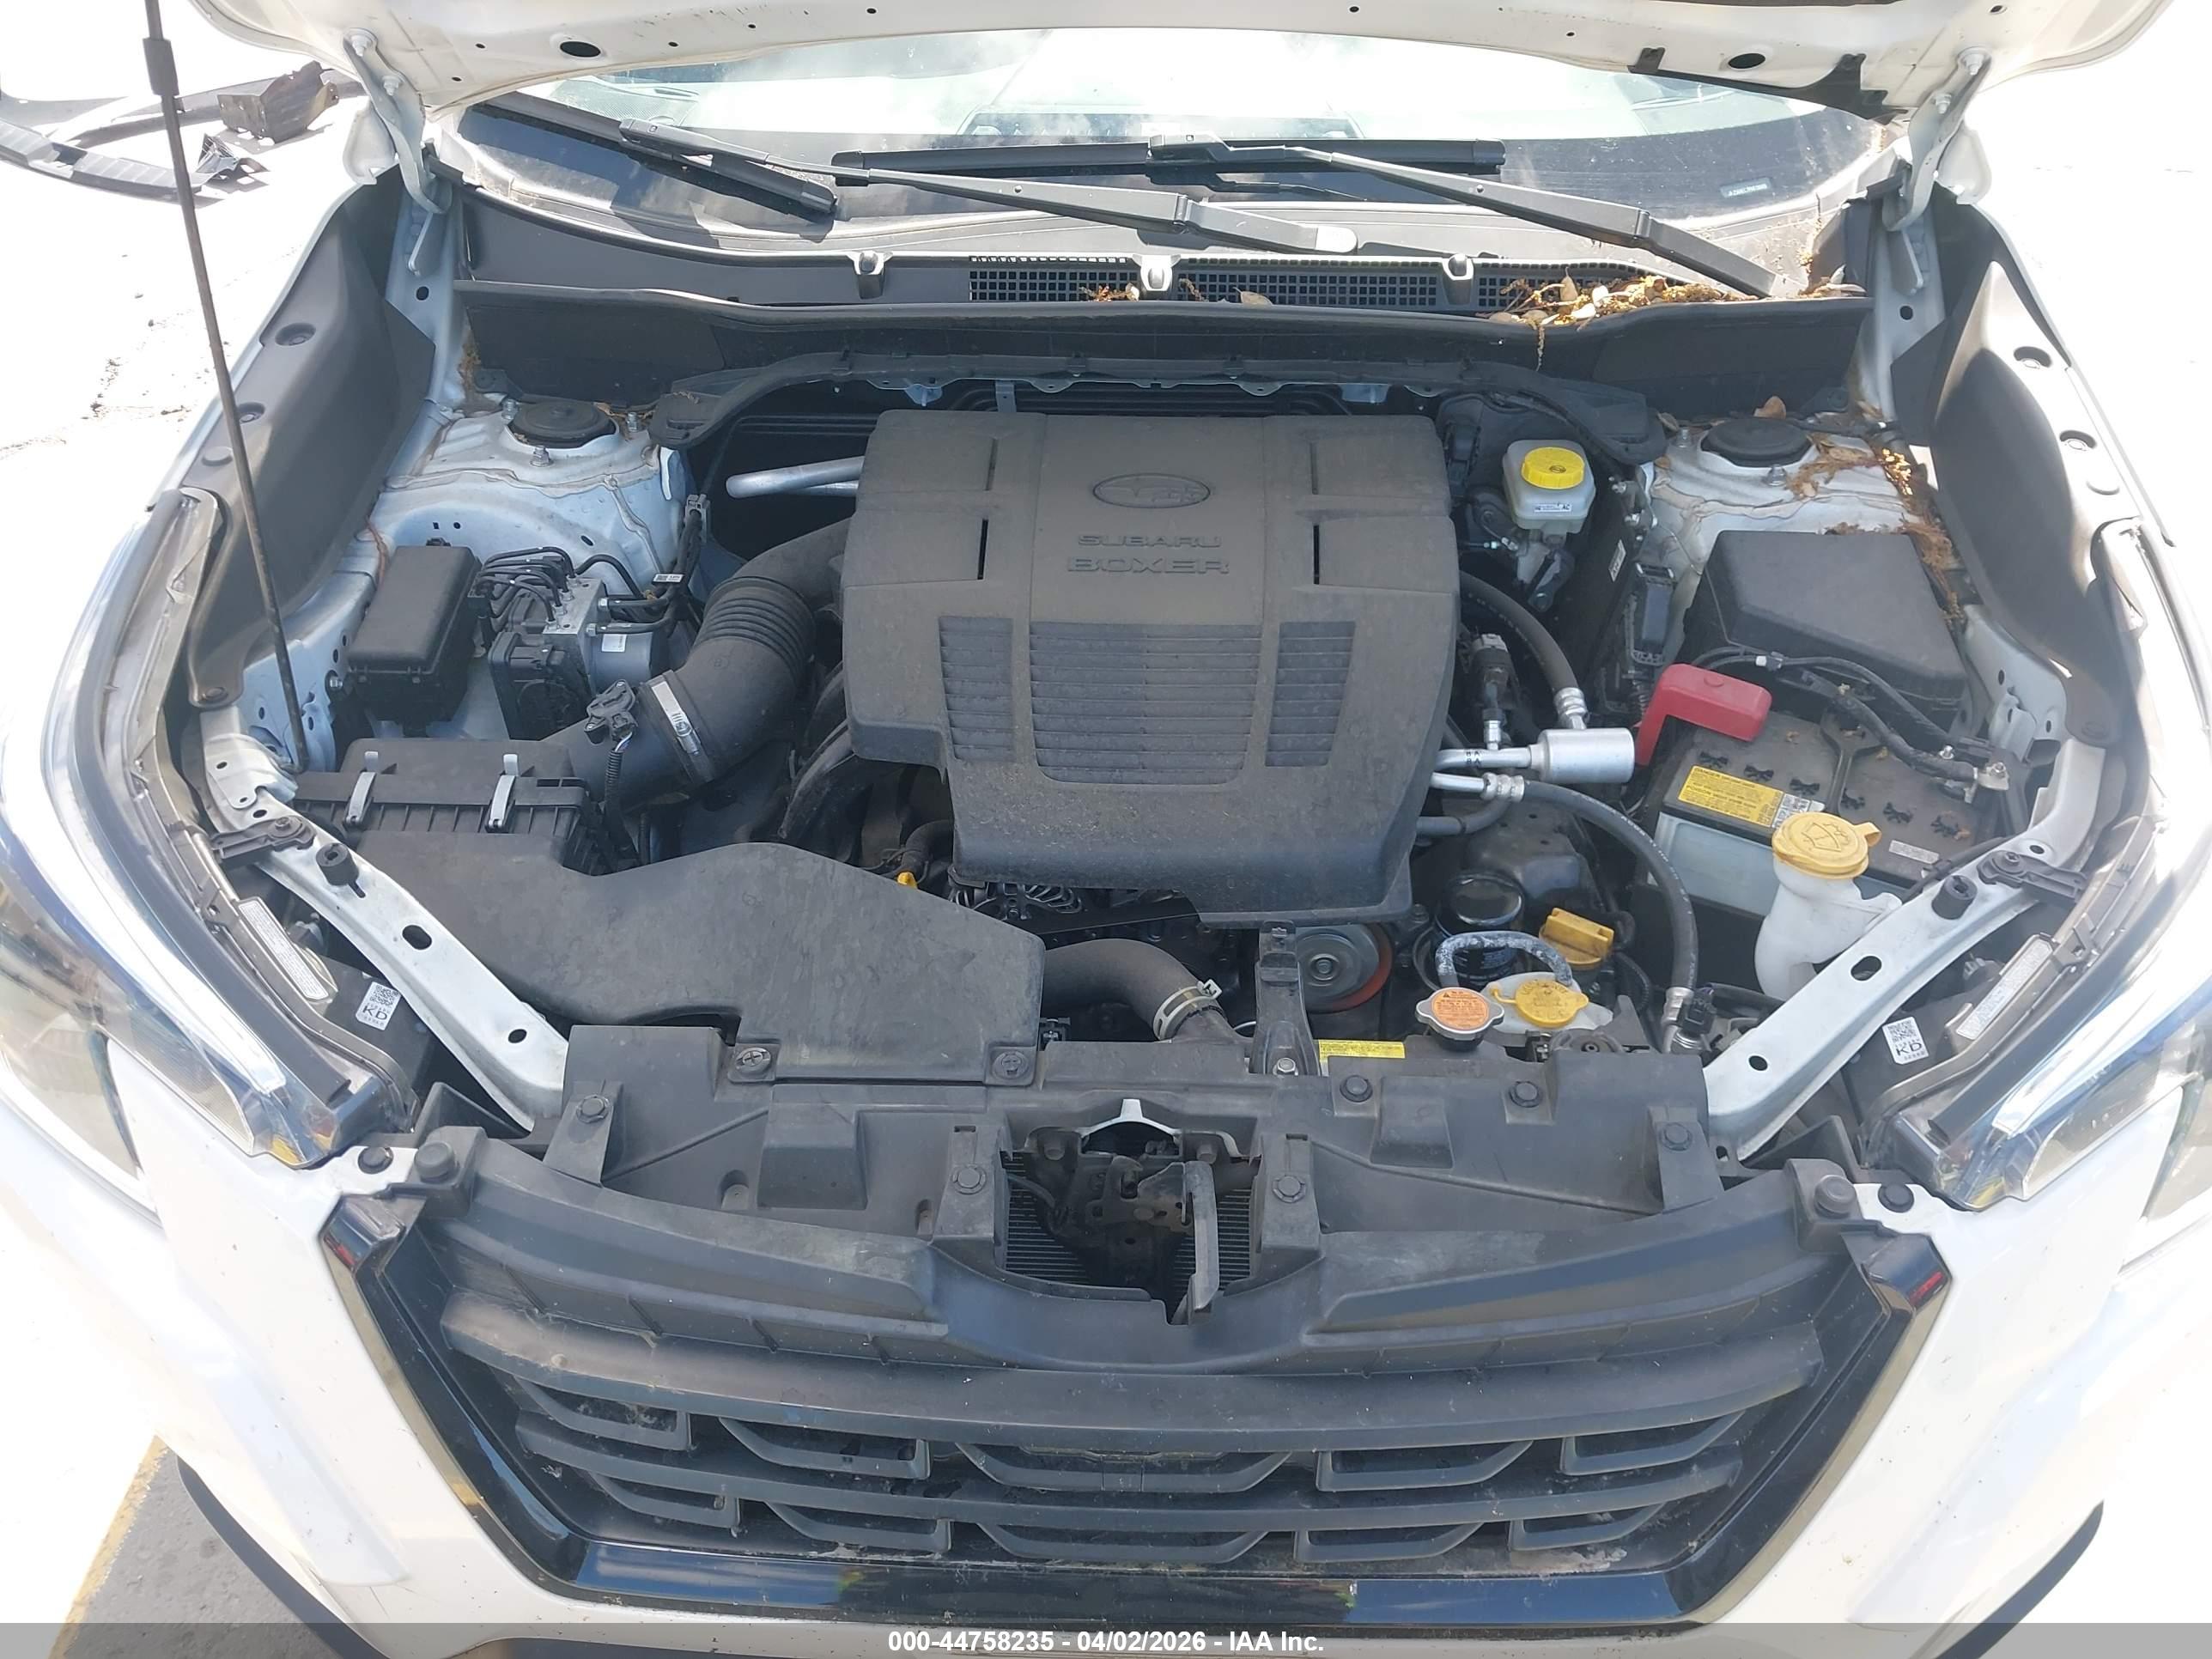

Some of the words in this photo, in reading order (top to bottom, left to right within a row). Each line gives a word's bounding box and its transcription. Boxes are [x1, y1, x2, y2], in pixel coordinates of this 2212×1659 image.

[1078, 535, 1223, 548] SUBARU
[1067, 556, 1231, 574] BOXER
[362, 1005, 388, 1021] KD
[1896, 1042, 1923, 1056] KD
